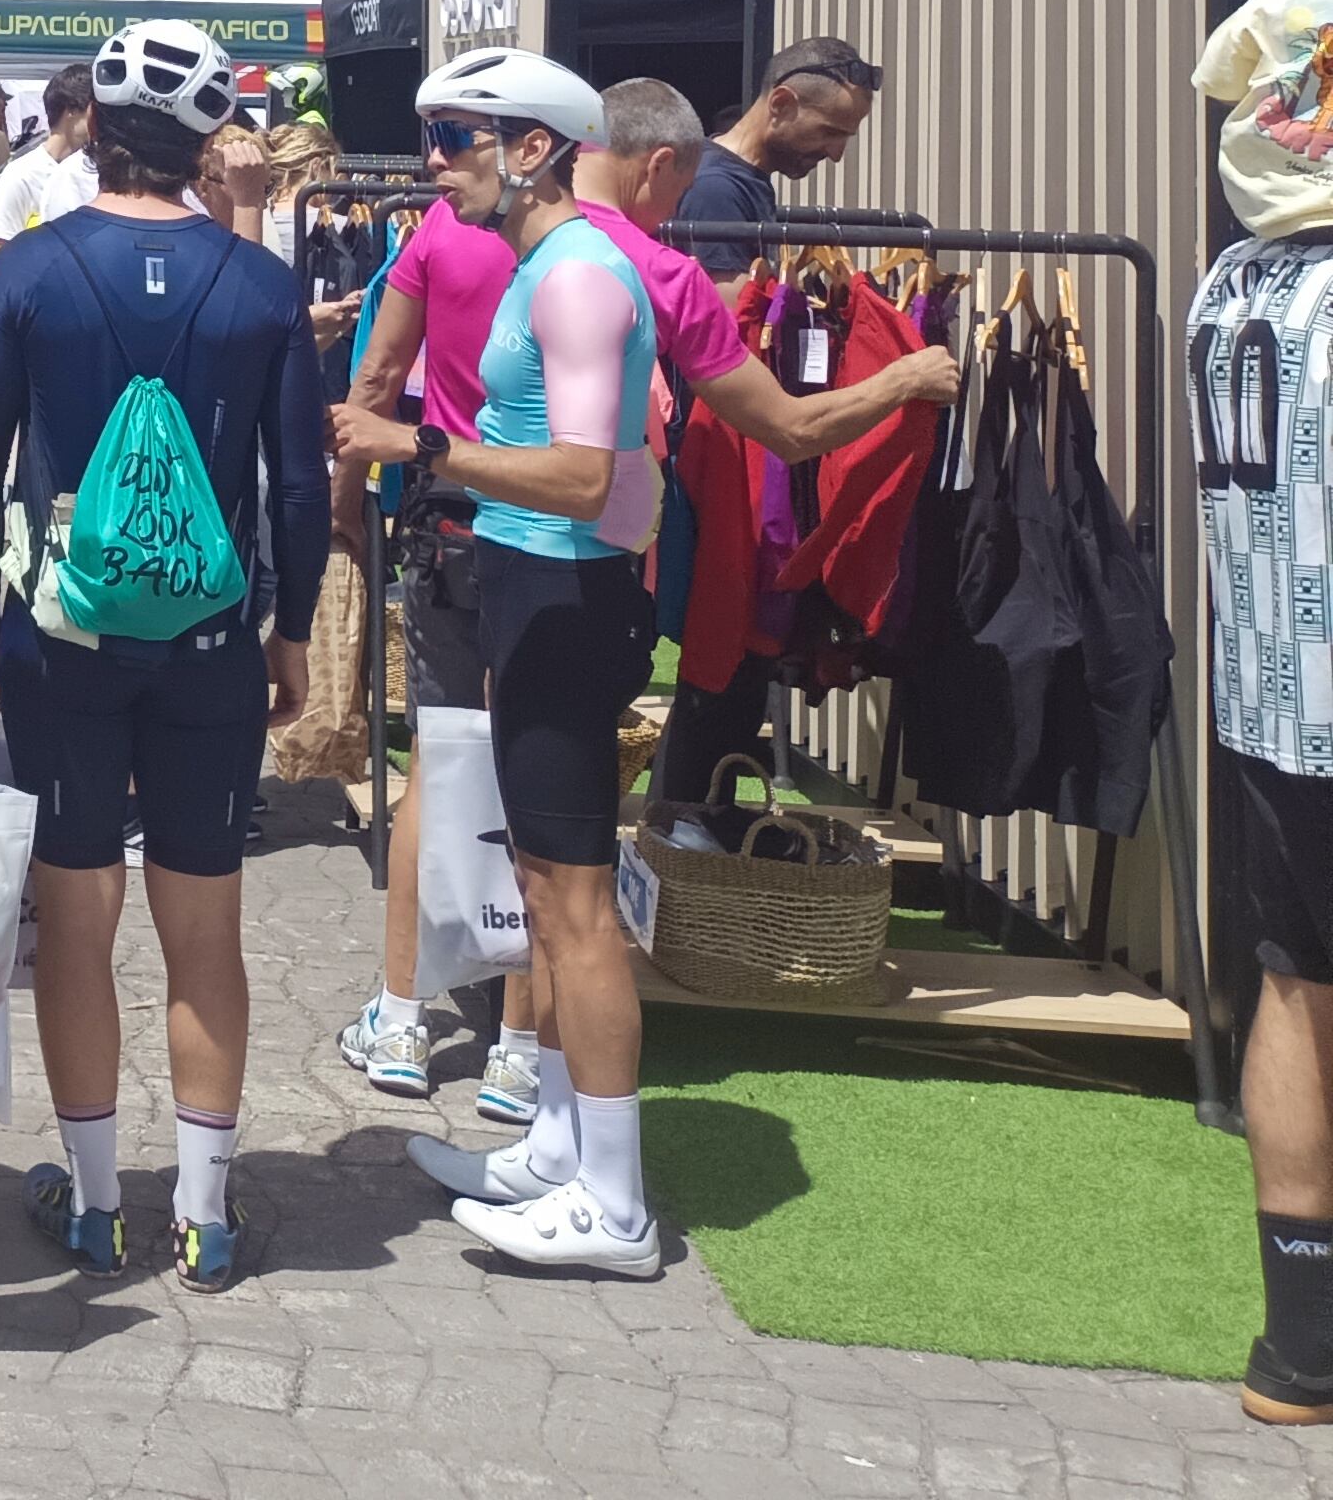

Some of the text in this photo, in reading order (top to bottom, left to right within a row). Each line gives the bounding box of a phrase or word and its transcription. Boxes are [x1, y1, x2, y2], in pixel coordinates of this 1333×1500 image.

[186, 18, 289, 41] RAFICO
[117, 501, 203, 552] LOOK
[101, 545, 221, 600] BACK
[481, 903, 530, 930] iber
[1272, 1235, 1333, 1257] VAN
